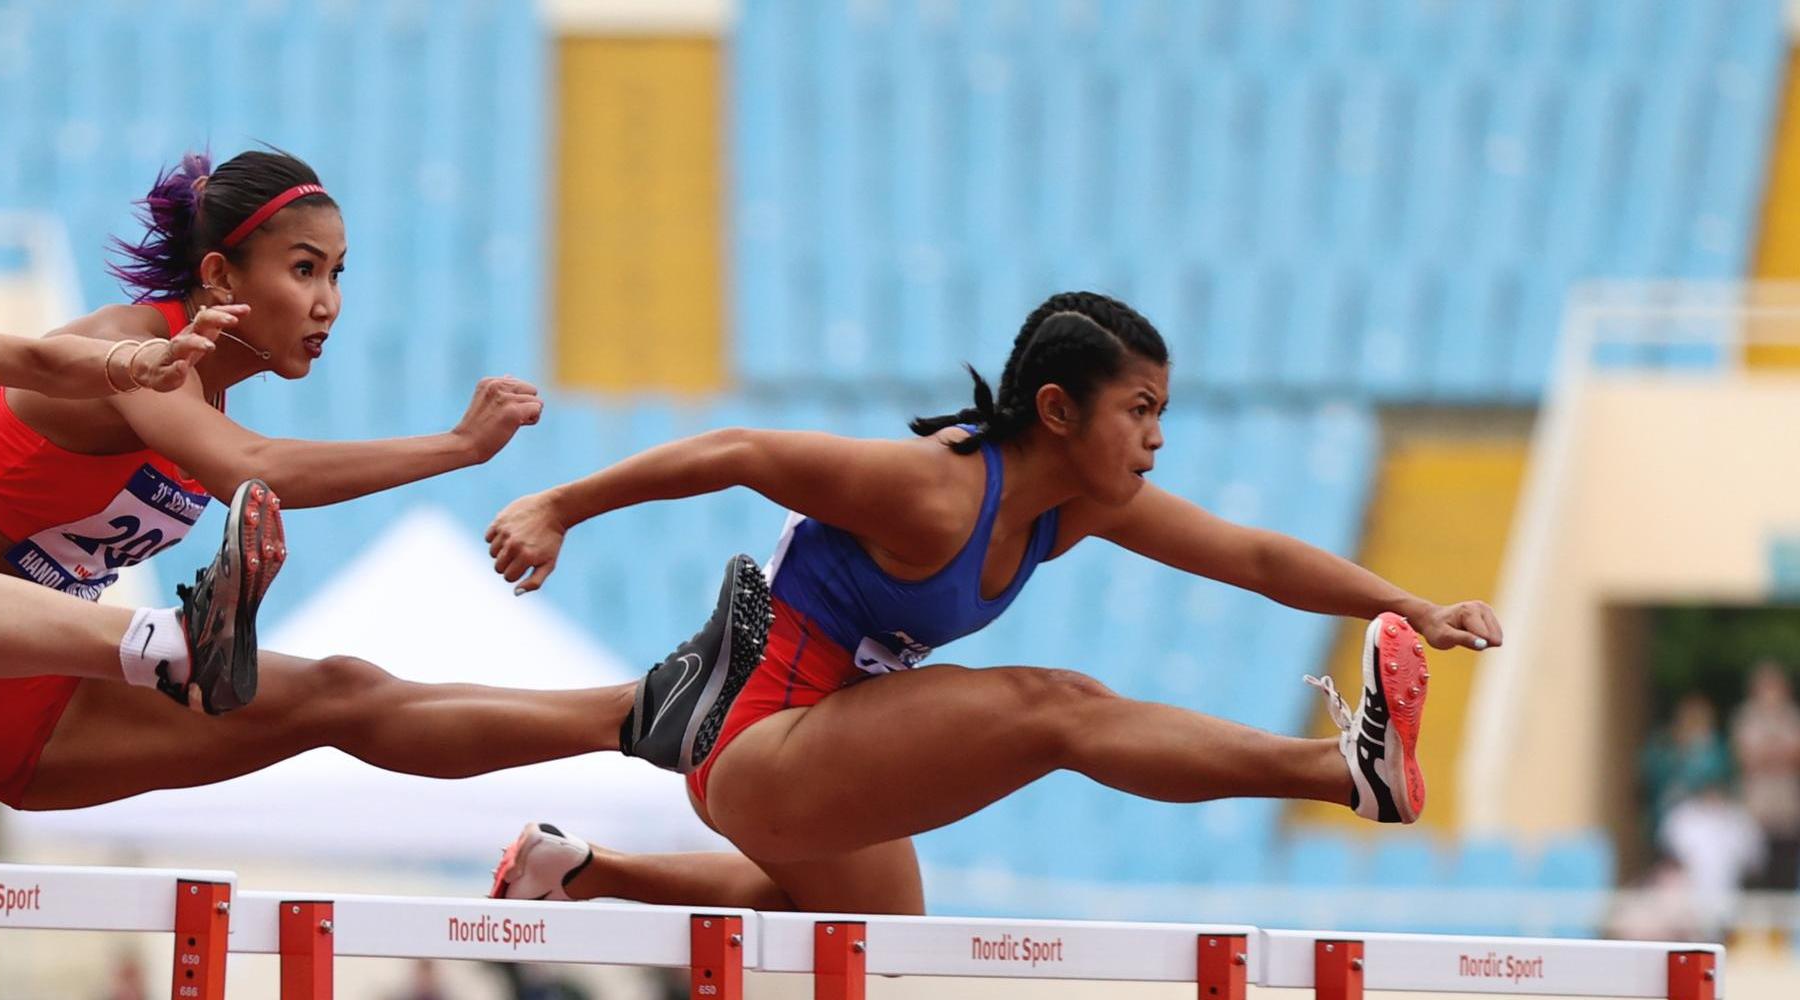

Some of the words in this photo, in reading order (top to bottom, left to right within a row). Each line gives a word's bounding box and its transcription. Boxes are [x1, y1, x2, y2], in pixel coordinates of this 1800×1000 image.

[18, 550, 65, 589] HANOI
[502, 918, 546, 950] Sport
[1022, 937, 1063, 967] Sport
[1505, 955, 1544, 984] Sport
